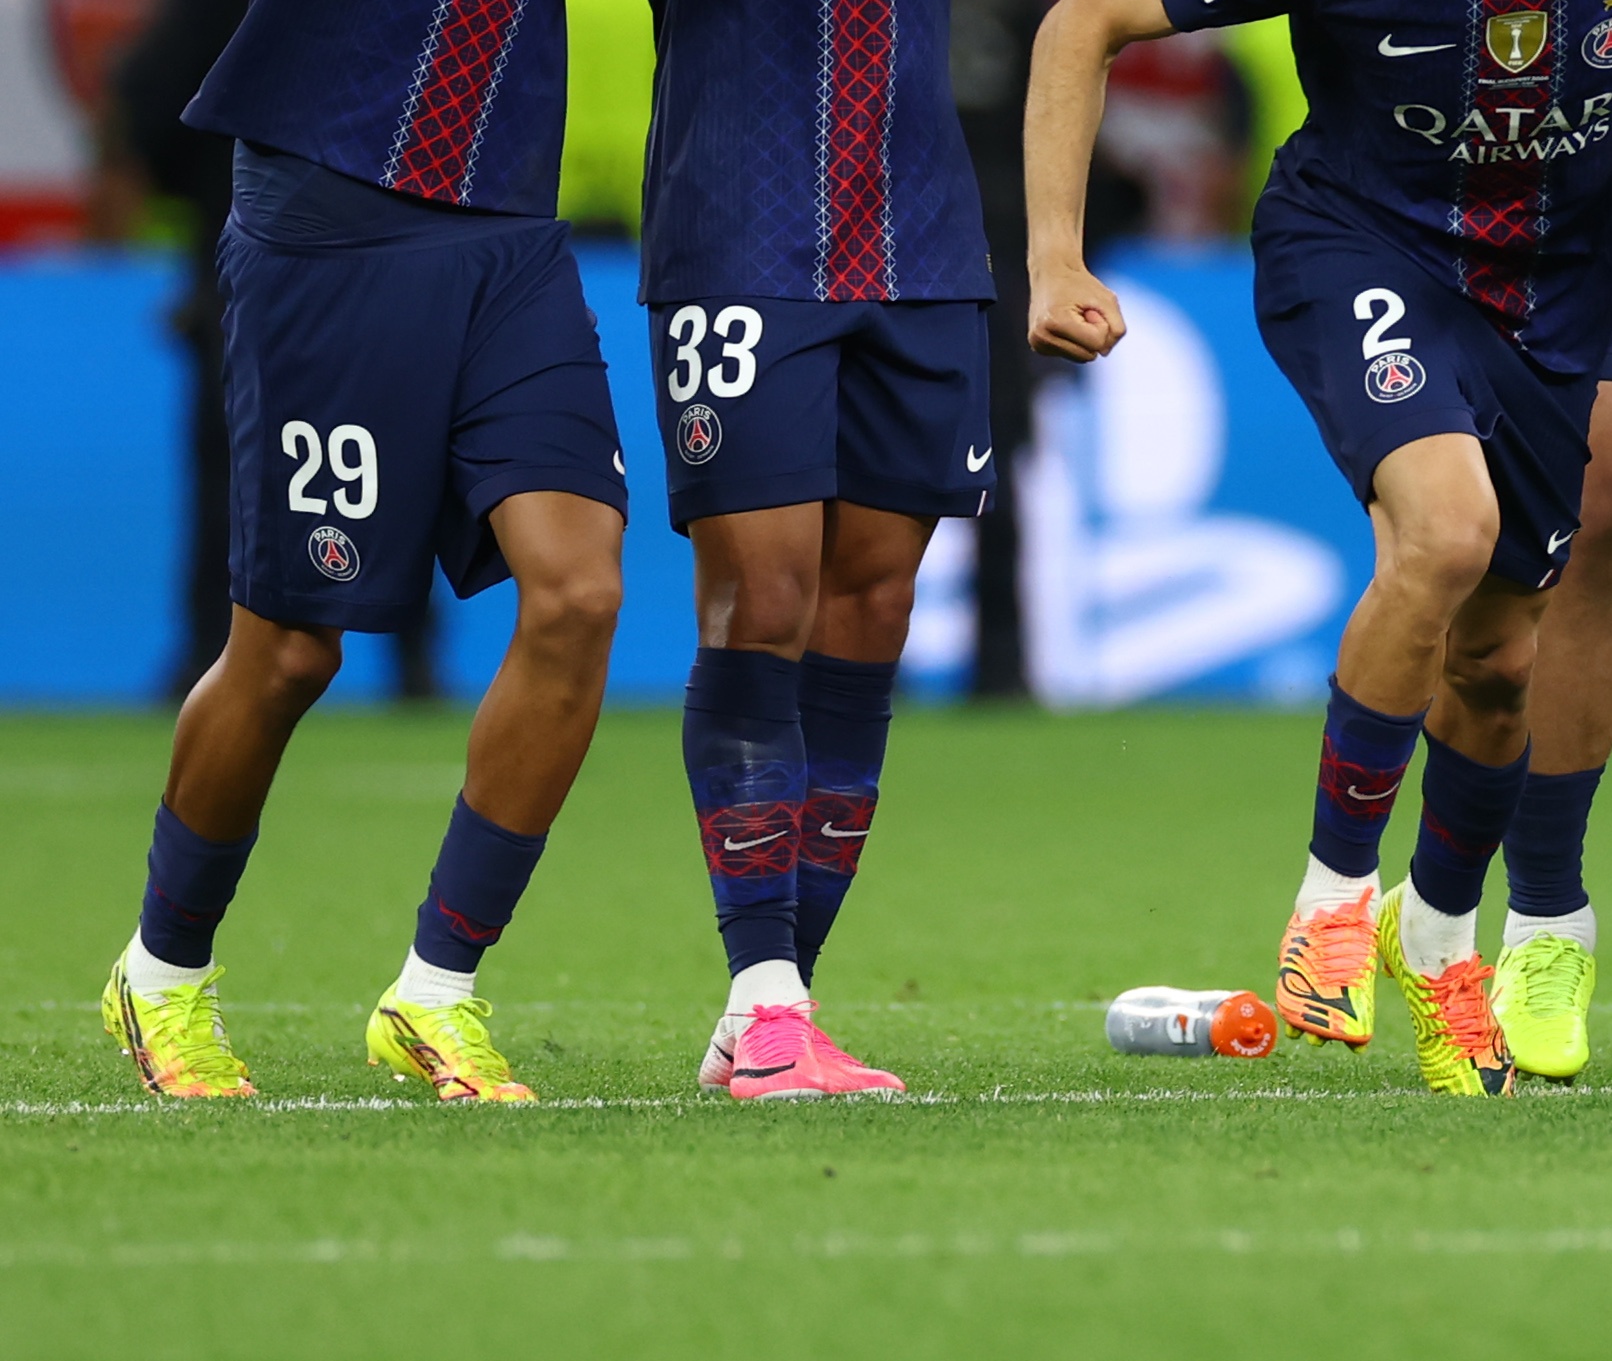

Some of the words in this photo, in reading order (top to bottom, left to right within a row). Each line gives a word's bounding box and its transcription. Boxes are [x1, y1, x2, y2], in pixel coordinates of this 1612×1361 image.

[1447, 117, 1610, 164] AIRWAYS
[1353, 287, 1412, 361] 2
[668, 305, 764, 403] 33
[1371, 355, 1411, 374] PARIS
[682, 407, 712, 425] PARIS
[281, 420, 379, 520] 29
[313, 529, 347, 546] PARIS
